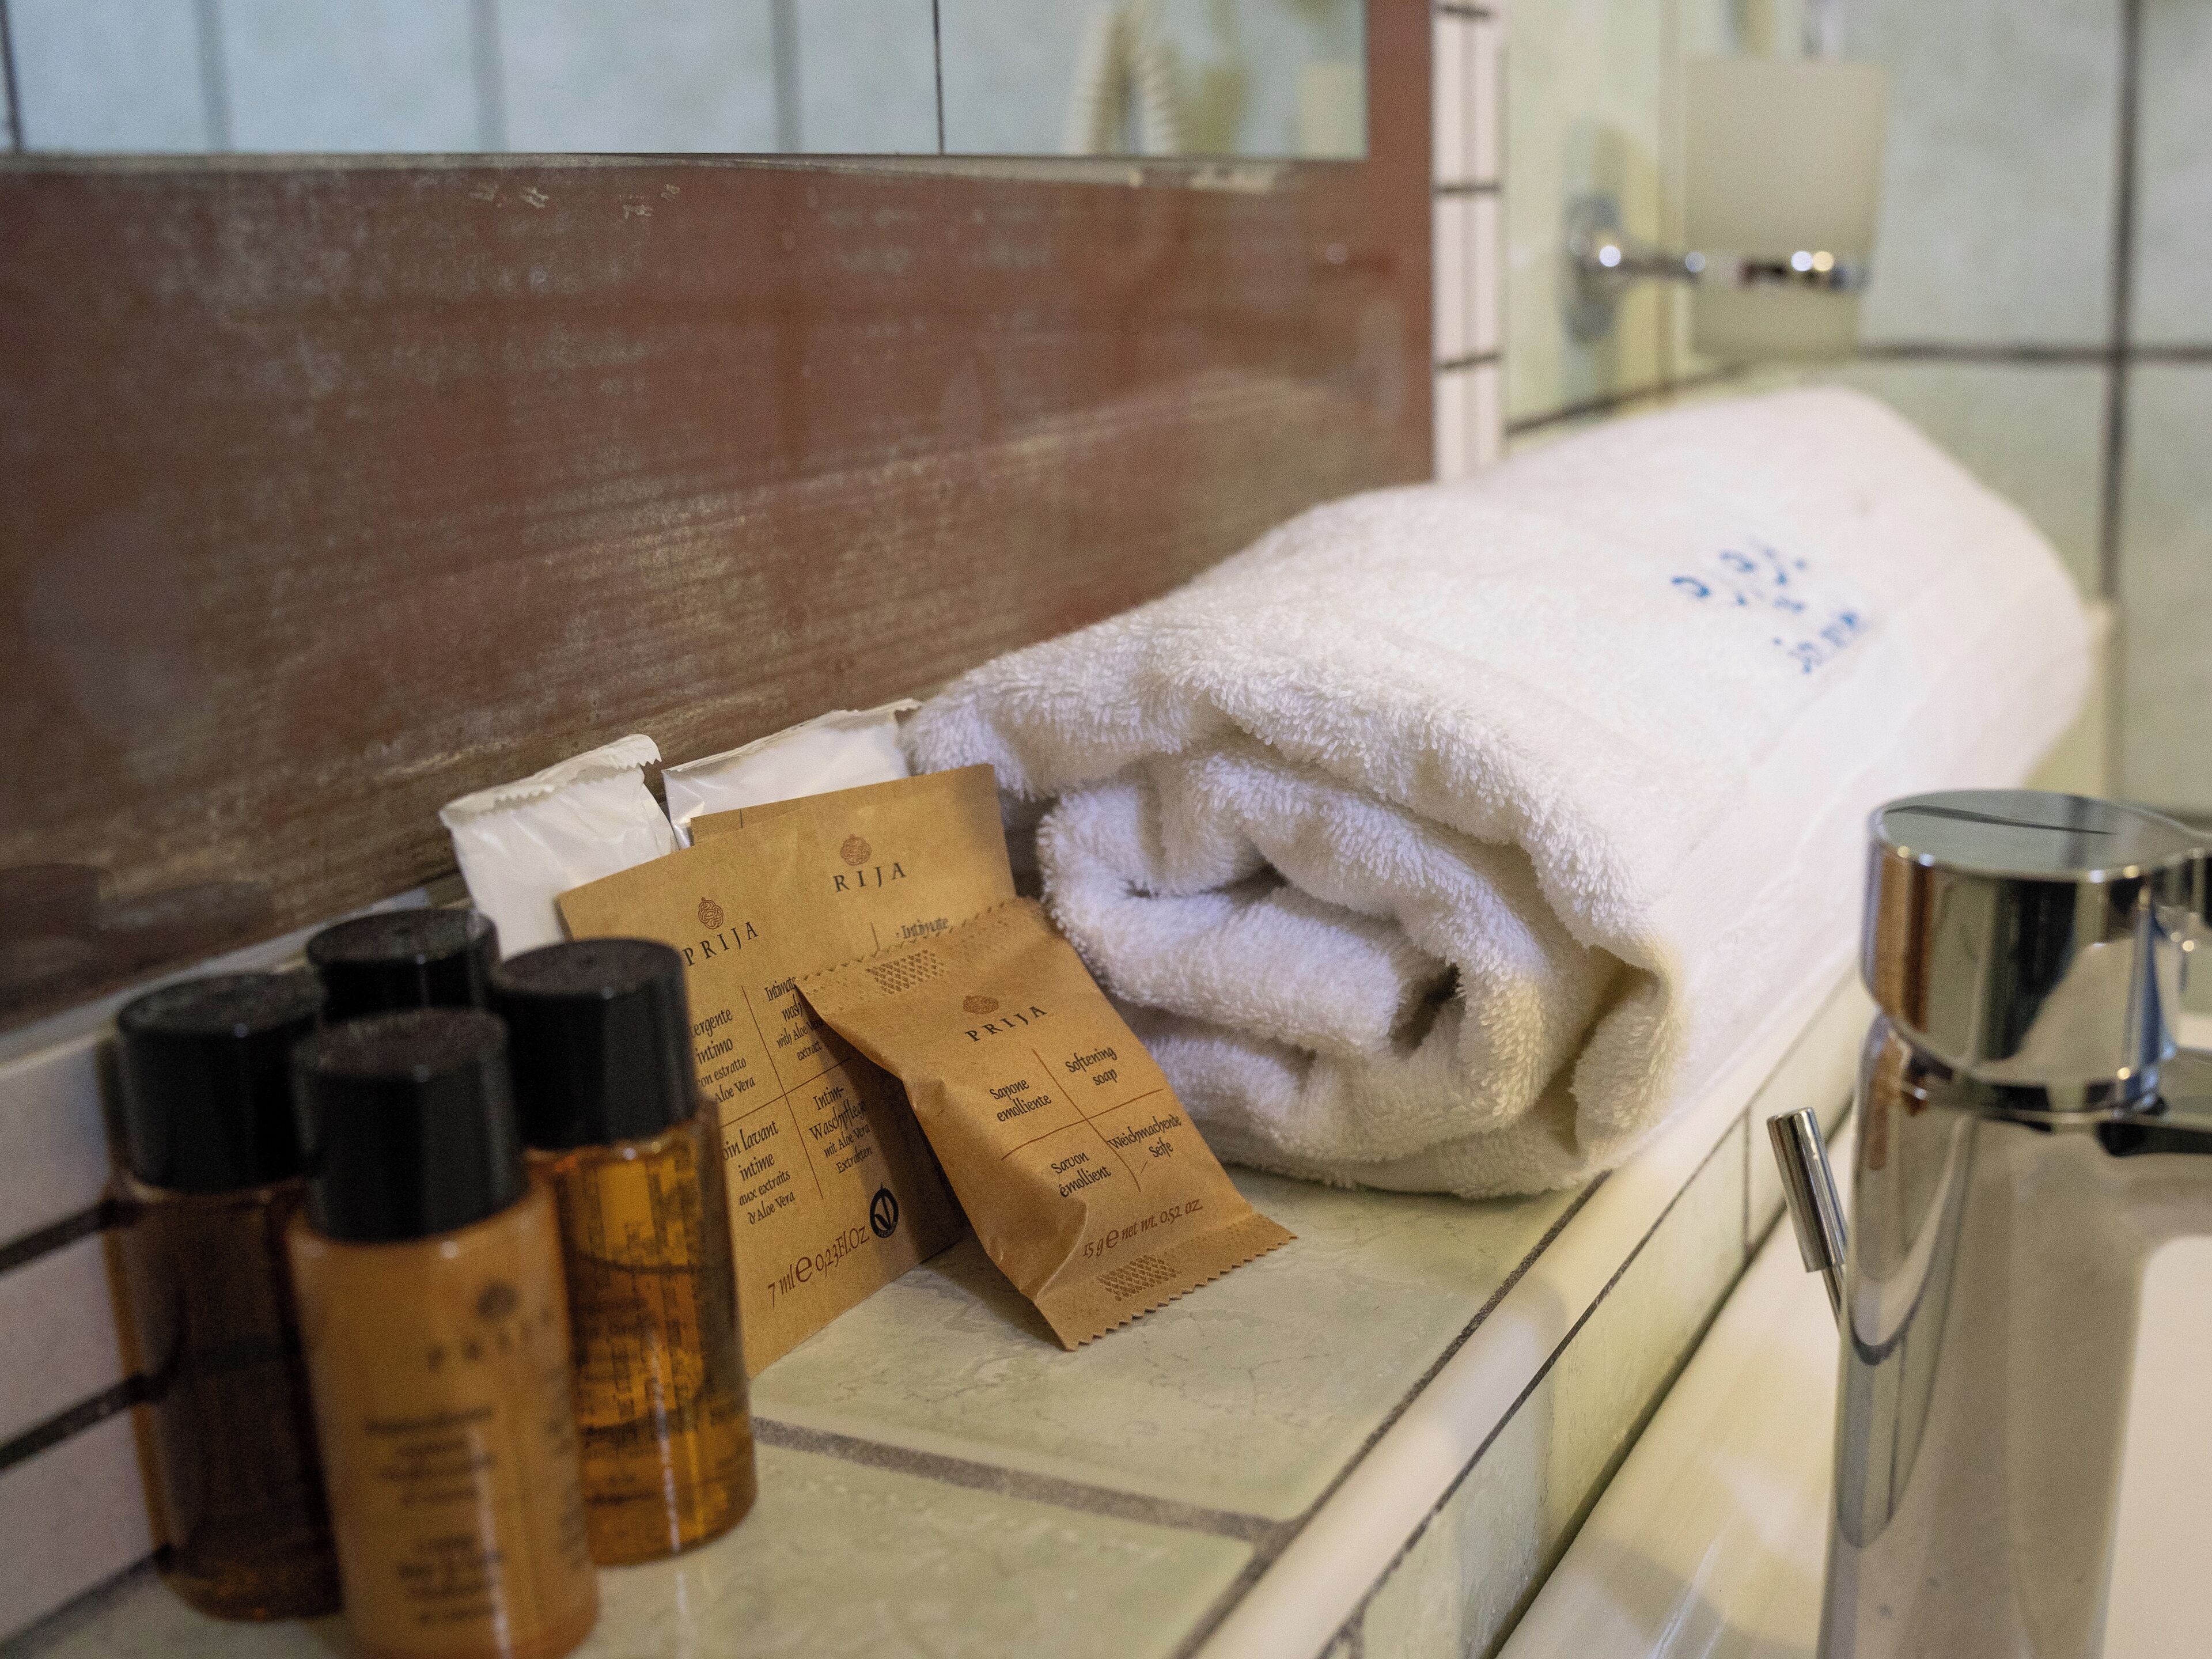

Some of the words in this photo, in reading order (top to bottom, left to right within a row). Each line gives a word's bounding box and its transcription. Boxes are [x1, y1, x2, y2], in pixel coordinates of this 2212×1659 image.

[832, 862, 906, 892] RIJA
[682, 922, 759, 967] PRIJA
[782, 994, 802, 1022] wash
[692, 1009, 733, 1037] ergente
[777, 1028, 792, 1048] with
[793, 1022, 807, 1040] Aloe
[965, 1005, 1047, 1042] PRIJA
[695, 1039, 733, 1065] intimo
[797, 1040, 821, 1060] extract
[1065, 1047, 1118, 1073] Softening
[699, 1075, 714, 1087] on
[714, 1058, 747, 1081] estratto
[734, 1077, 756, 1093] Vera
[1092, 1069, 1118, 1086] soap
[813, 1086, 844, 1111] Intim-
[990, 1080, 1029, 1100] Sapone
[809, 1099, 866, 1141] Waschpflege
[997, 1094, 1052, 1122] emolliente
[722, 1141, 741, 1161] oin
[740, 1121, 779, 1150] lavant
[824, 1142, 837, 1158] mit
[838, 1131, 854, 1150] Aloe
[853, 1124, 871, 1139] Vera
[1107, 1113, 1181, 1149] Weichmachende
[836, 1146, 872, 1173] Extrakten
[1149, 1137, 1173, 1158] Seife
[738, 1154, 775, 1181] intime
[1051, 1152, 1090, 1175] Savon
[740, 1189, 757, 1206] aux
[759, 1171, 790, 1195] extraits
[1059, 1166, 1112, 1198] émollient
[748, 1200, 775, 1224] d'Aloe
[775, 1192, 795, 1208] Vera
[1096, 1238, 1104, 1257] g
[1122, 1222, 1138, 1239] net
[1141, 1214, 1158, 1232] wt.
[768, 1282, 775, 1309] 7
[779, 1264, 796, 1295] ml
